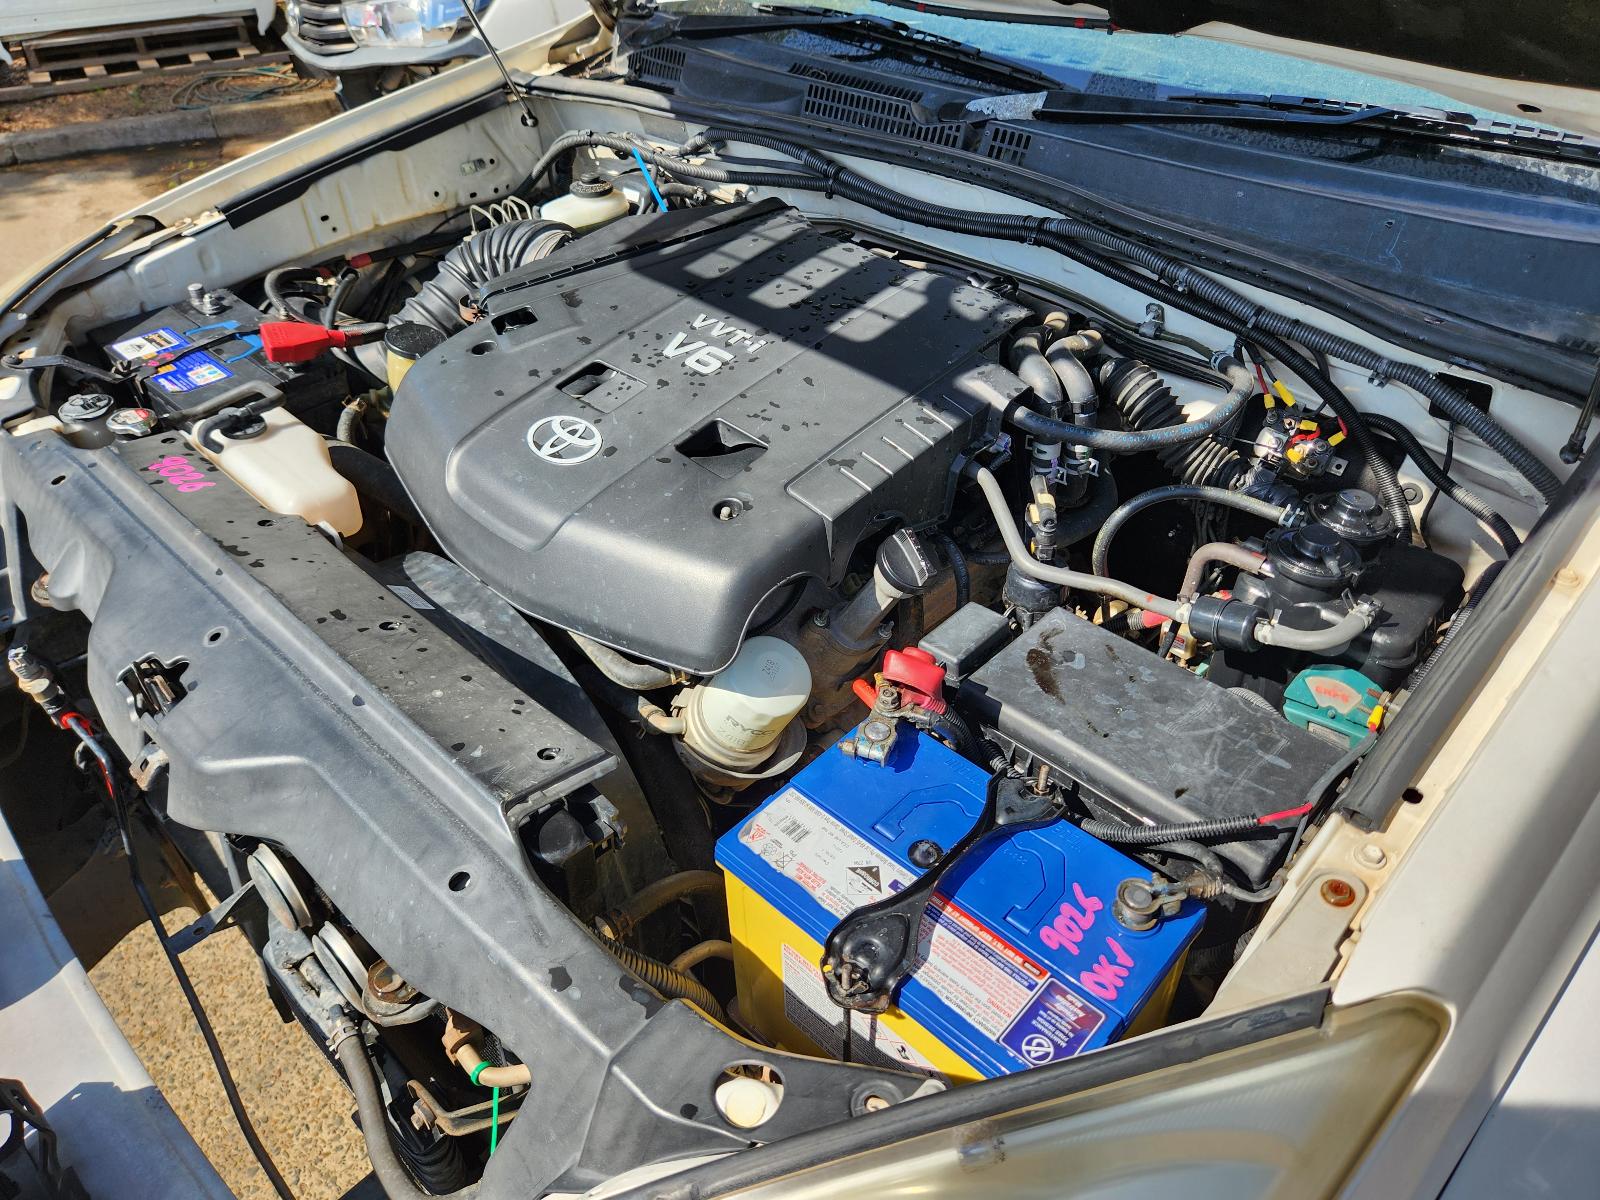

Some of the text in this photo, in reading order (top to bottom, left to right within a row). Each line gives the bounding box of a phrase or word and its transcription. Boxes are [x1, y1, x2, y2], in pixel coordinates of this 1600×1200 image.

[662, 331, 736, 376] V6
[692, 313, 768, 354] VVT-i
[854, 866, 880, 888] CORROSIVE
[1039, 882, 1104, 956] 9026
[1030, 1018, 1067, 1049] MAINTENANCE
